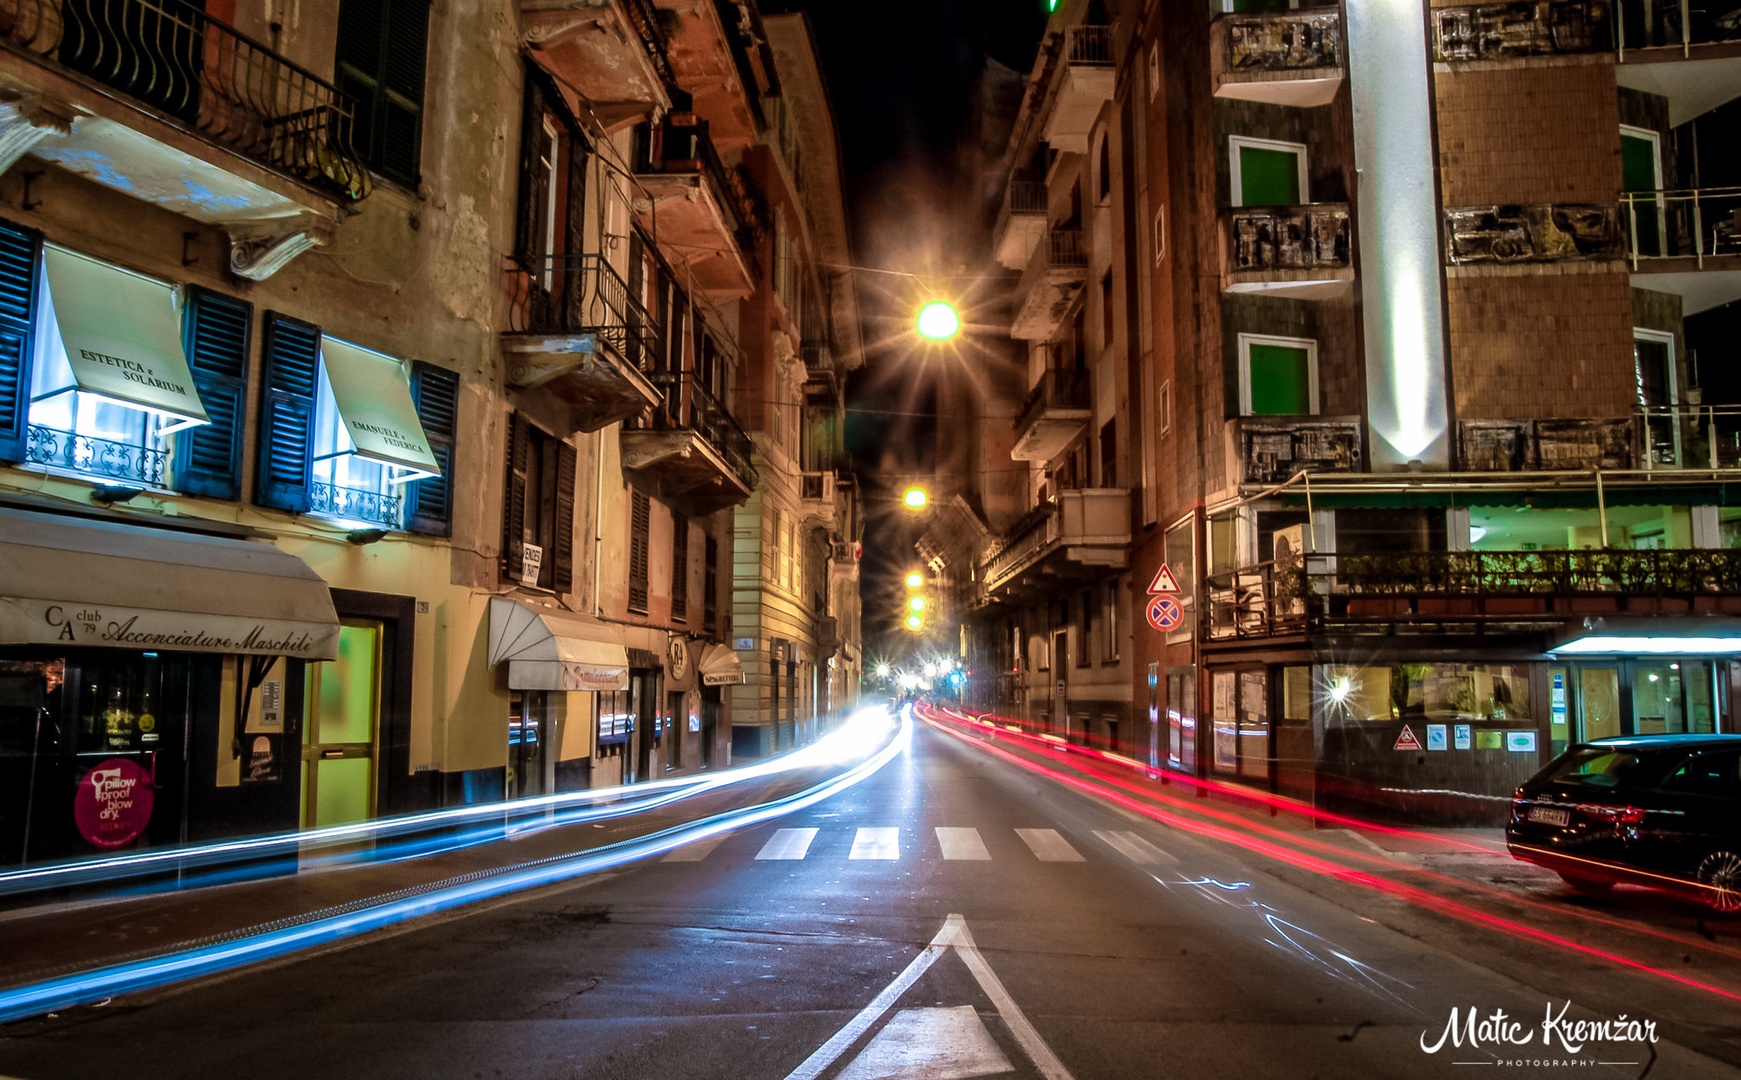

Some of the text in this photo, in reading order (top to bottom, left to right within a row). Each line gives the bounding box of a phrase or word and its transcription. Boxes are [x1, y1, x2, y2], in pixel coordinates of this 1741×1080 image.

[80, 348, 154, 376] ESTETICA e
[122, 370, 187, 396] SOLARIUM
[352, 420, 400, 439] EMANUELE
[383, 436, 424, 454] FEDERICA
[76, 609, 102, 623] club
[83, 622, 97, 634] 79
[101, 615, 313, 652] Acconciature Maschili
[105, 778, 136, 792] pillow
[101, 786, 131, 802] proof
[107, 799, 133, 811] blow
